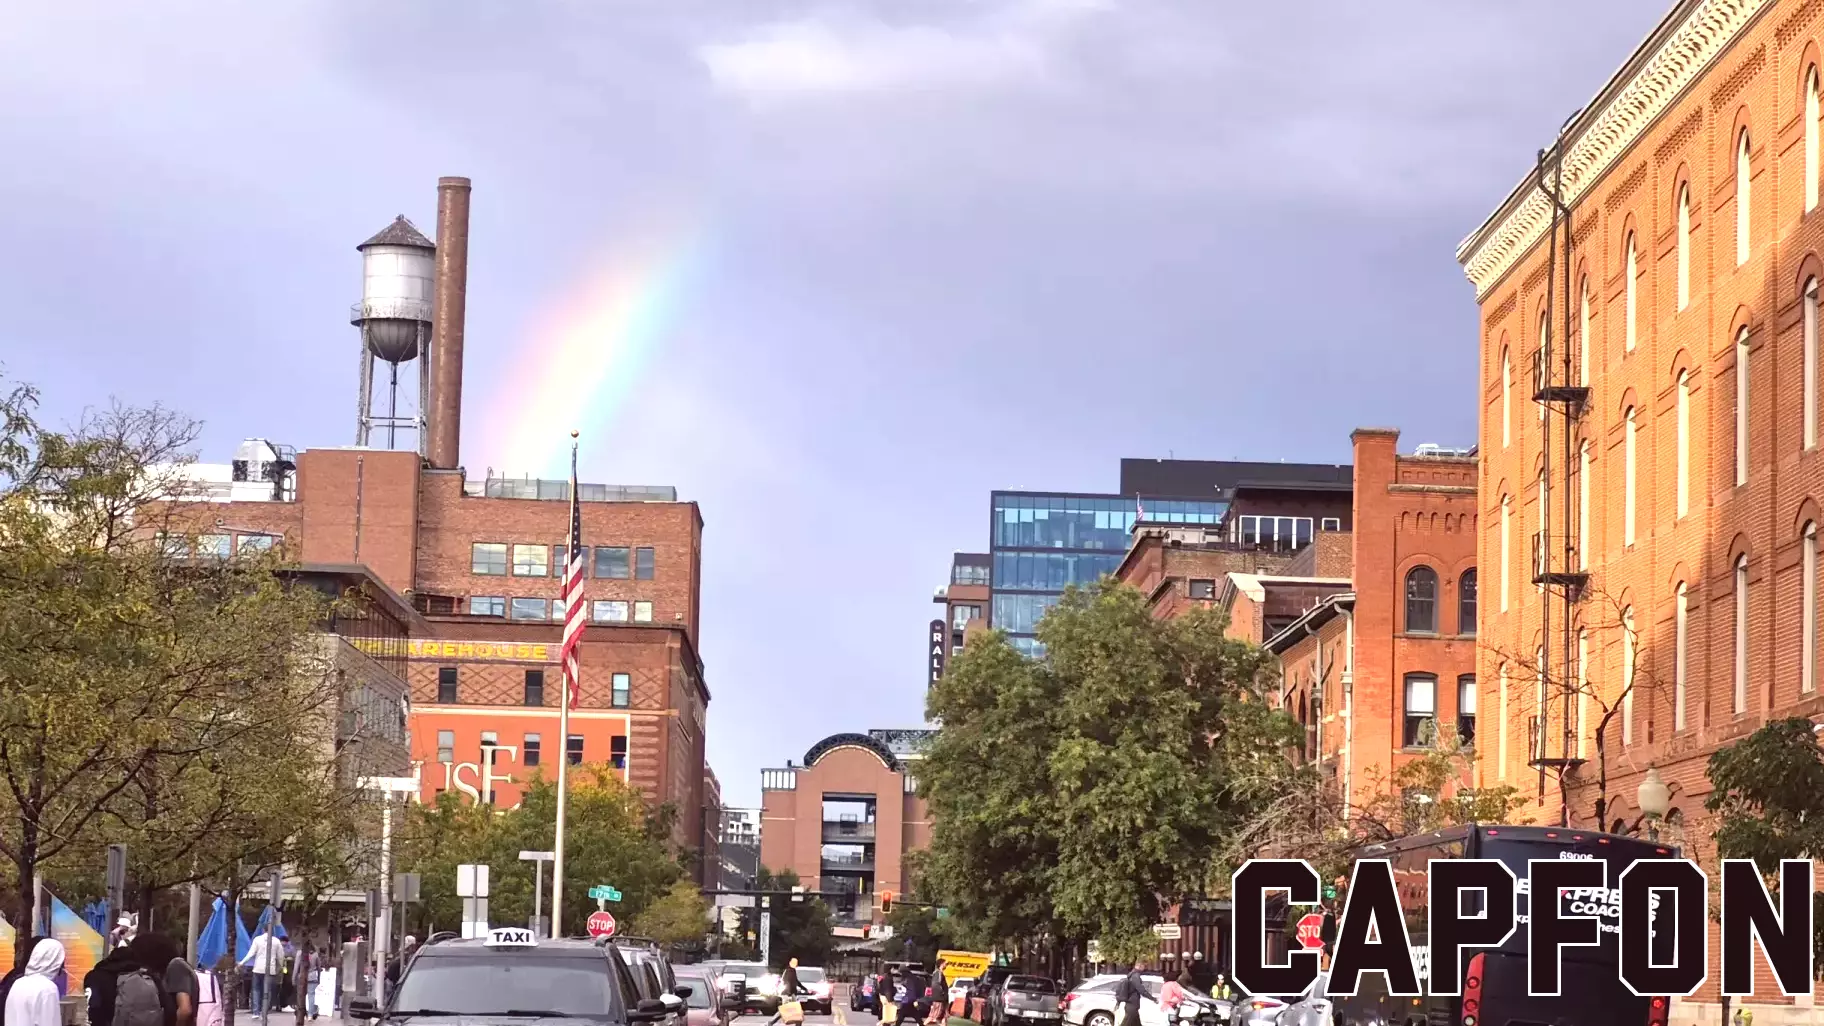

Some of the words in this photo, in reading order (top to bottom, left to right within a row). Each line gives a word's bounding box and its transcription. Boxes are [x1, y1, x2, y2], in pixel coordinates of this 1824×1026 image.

[590, 919, 613, 931] STOP
[493, 932, 530, 943] TAXI
[1299, 925, 1321, 938] STO
